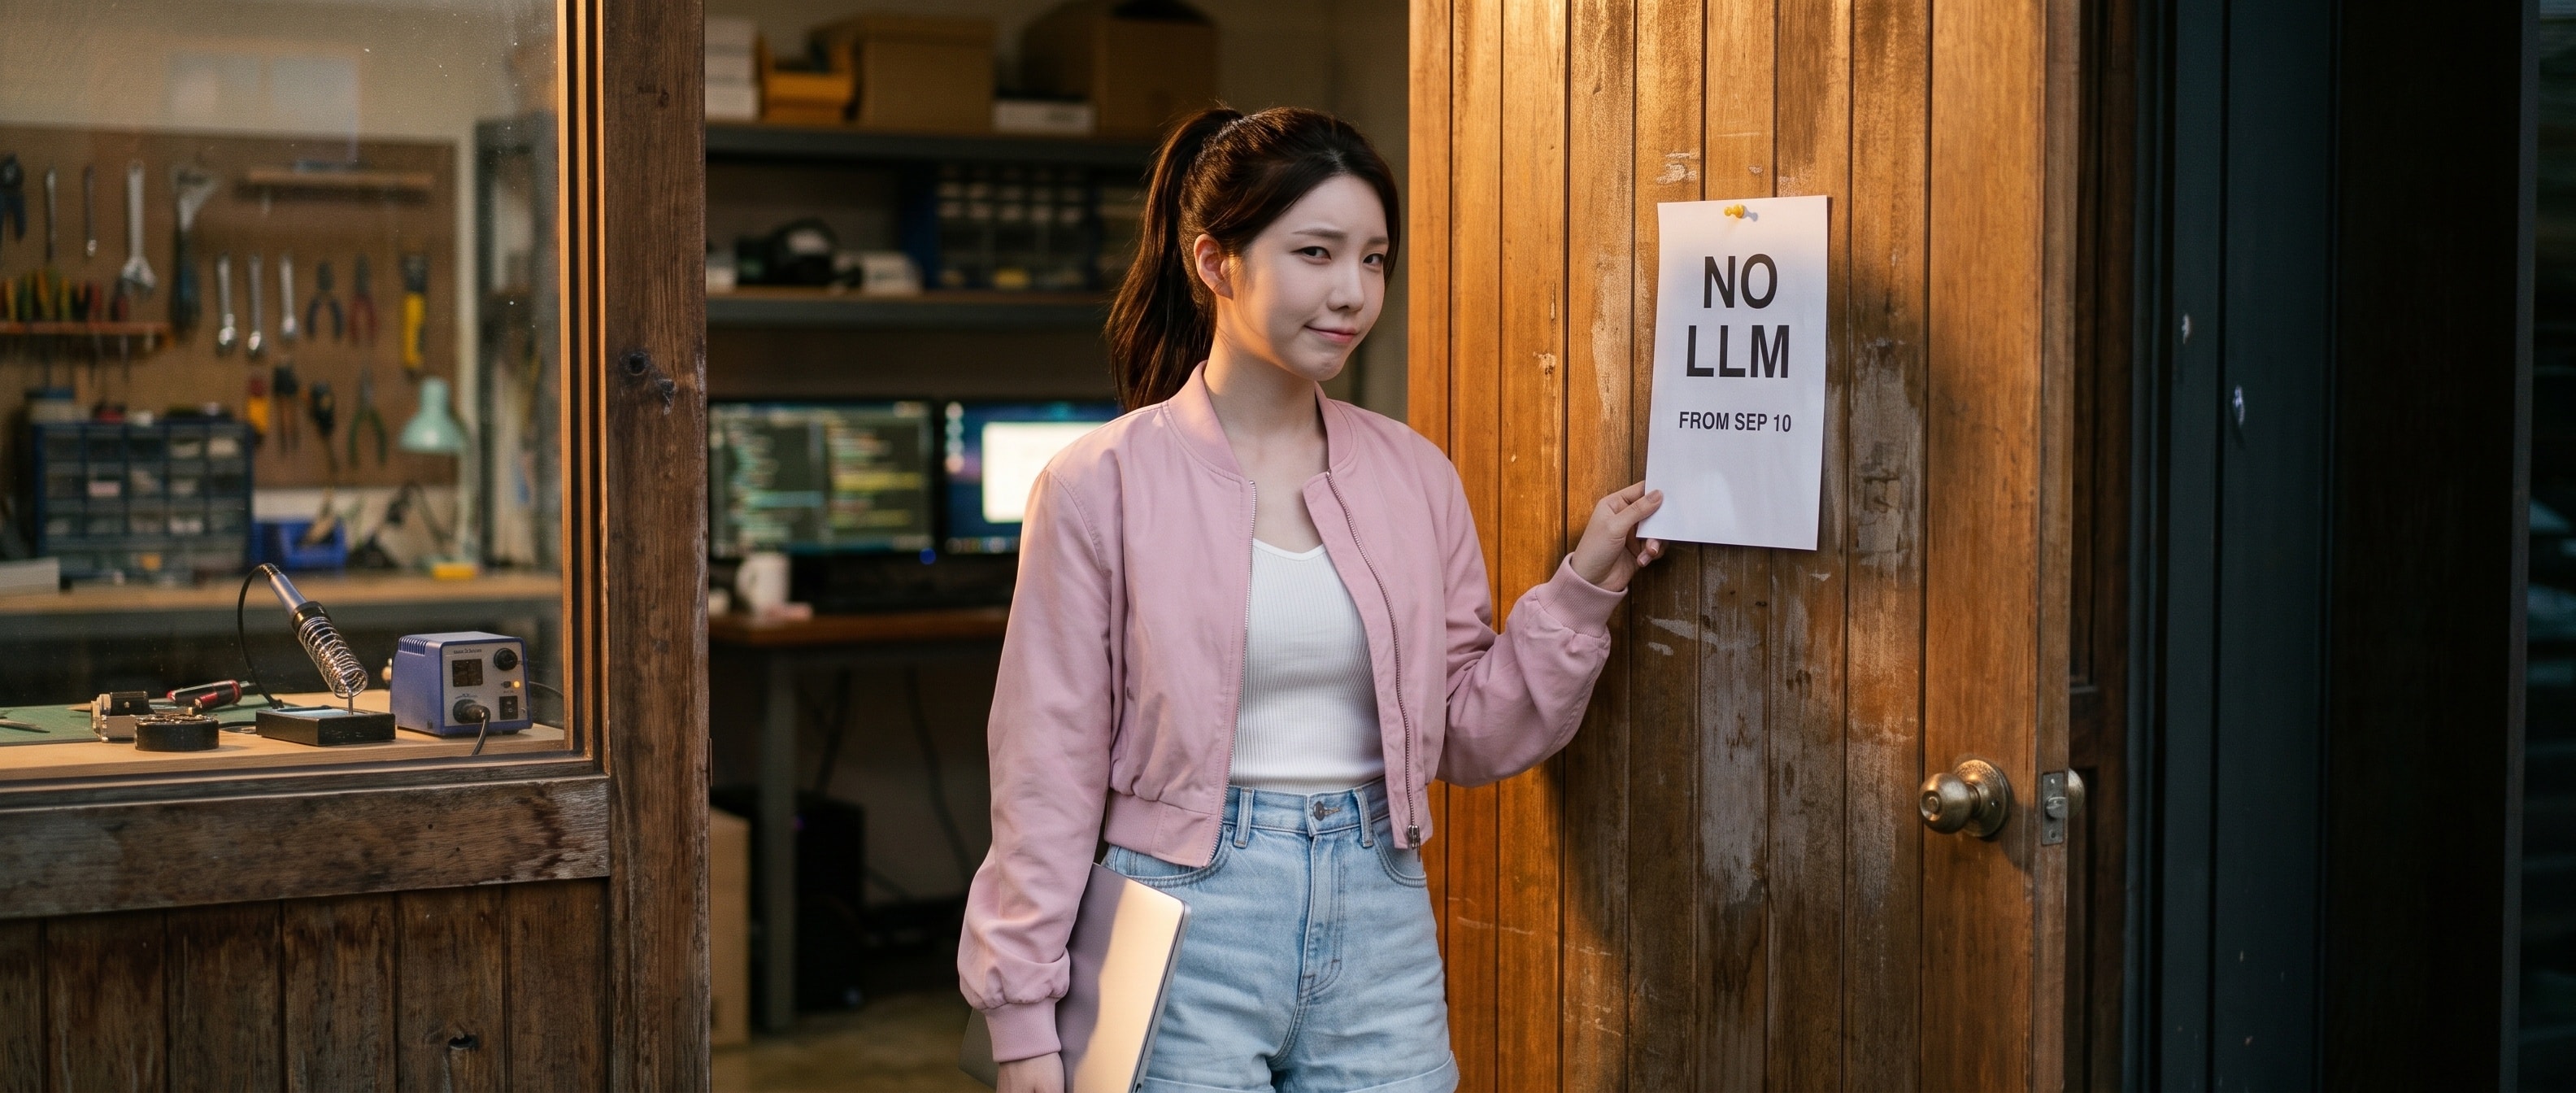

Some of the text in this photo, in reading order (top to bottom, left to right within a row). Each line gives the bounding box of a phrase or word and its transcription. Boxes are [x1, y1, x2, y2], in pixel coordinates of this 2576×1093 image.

[1704, 254, 1778, 309] NO
[1686, 324, 1790, 379] LLM
[1679, 411, 1792, 433] FROM SEP 10
